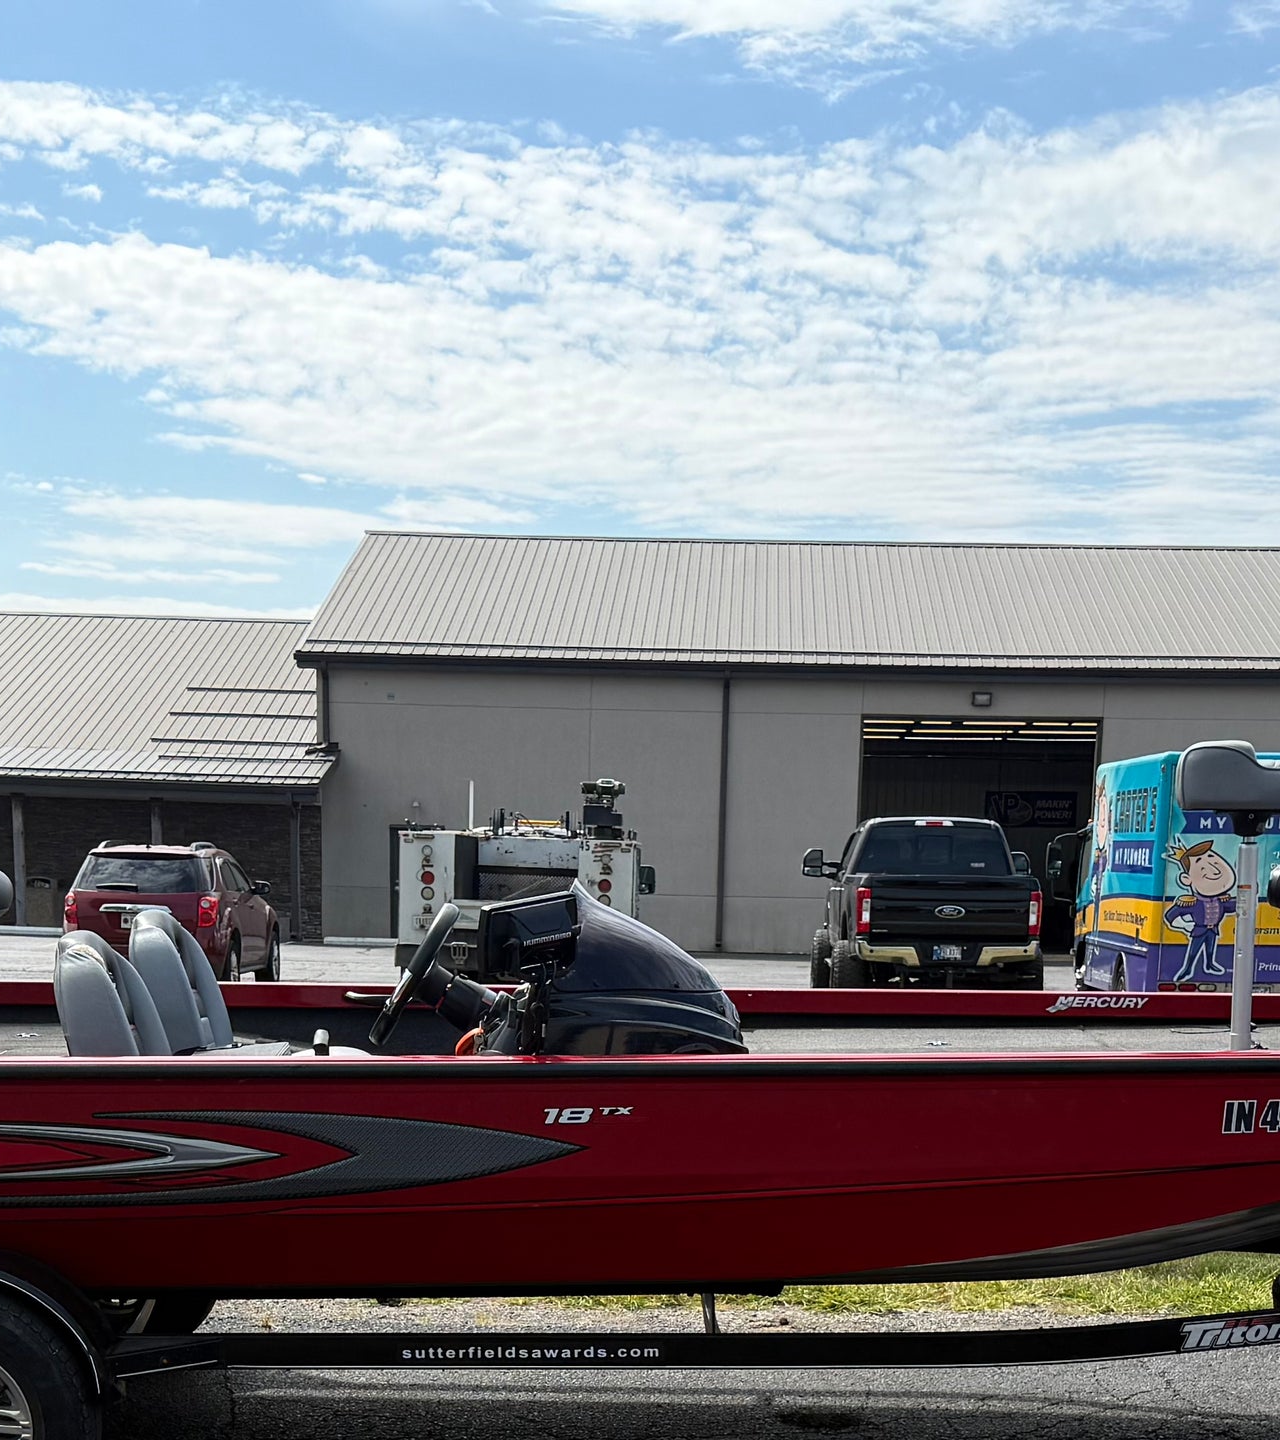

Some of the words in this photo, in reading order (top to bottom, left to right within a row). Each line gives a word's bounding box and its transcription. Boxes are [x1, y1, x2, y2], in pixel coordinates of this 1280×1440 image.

[1200, 817, 1227, 829] MY
[1049, 996, 1148, 1011] MERCURY
[543, 1107, 594, 1124] 18
[599, 1106, 634, 1115] TX
[1222, 1100, 1257, 1134] IN
[402, 1345, 660, 1359] sutterfieldsawards.com
